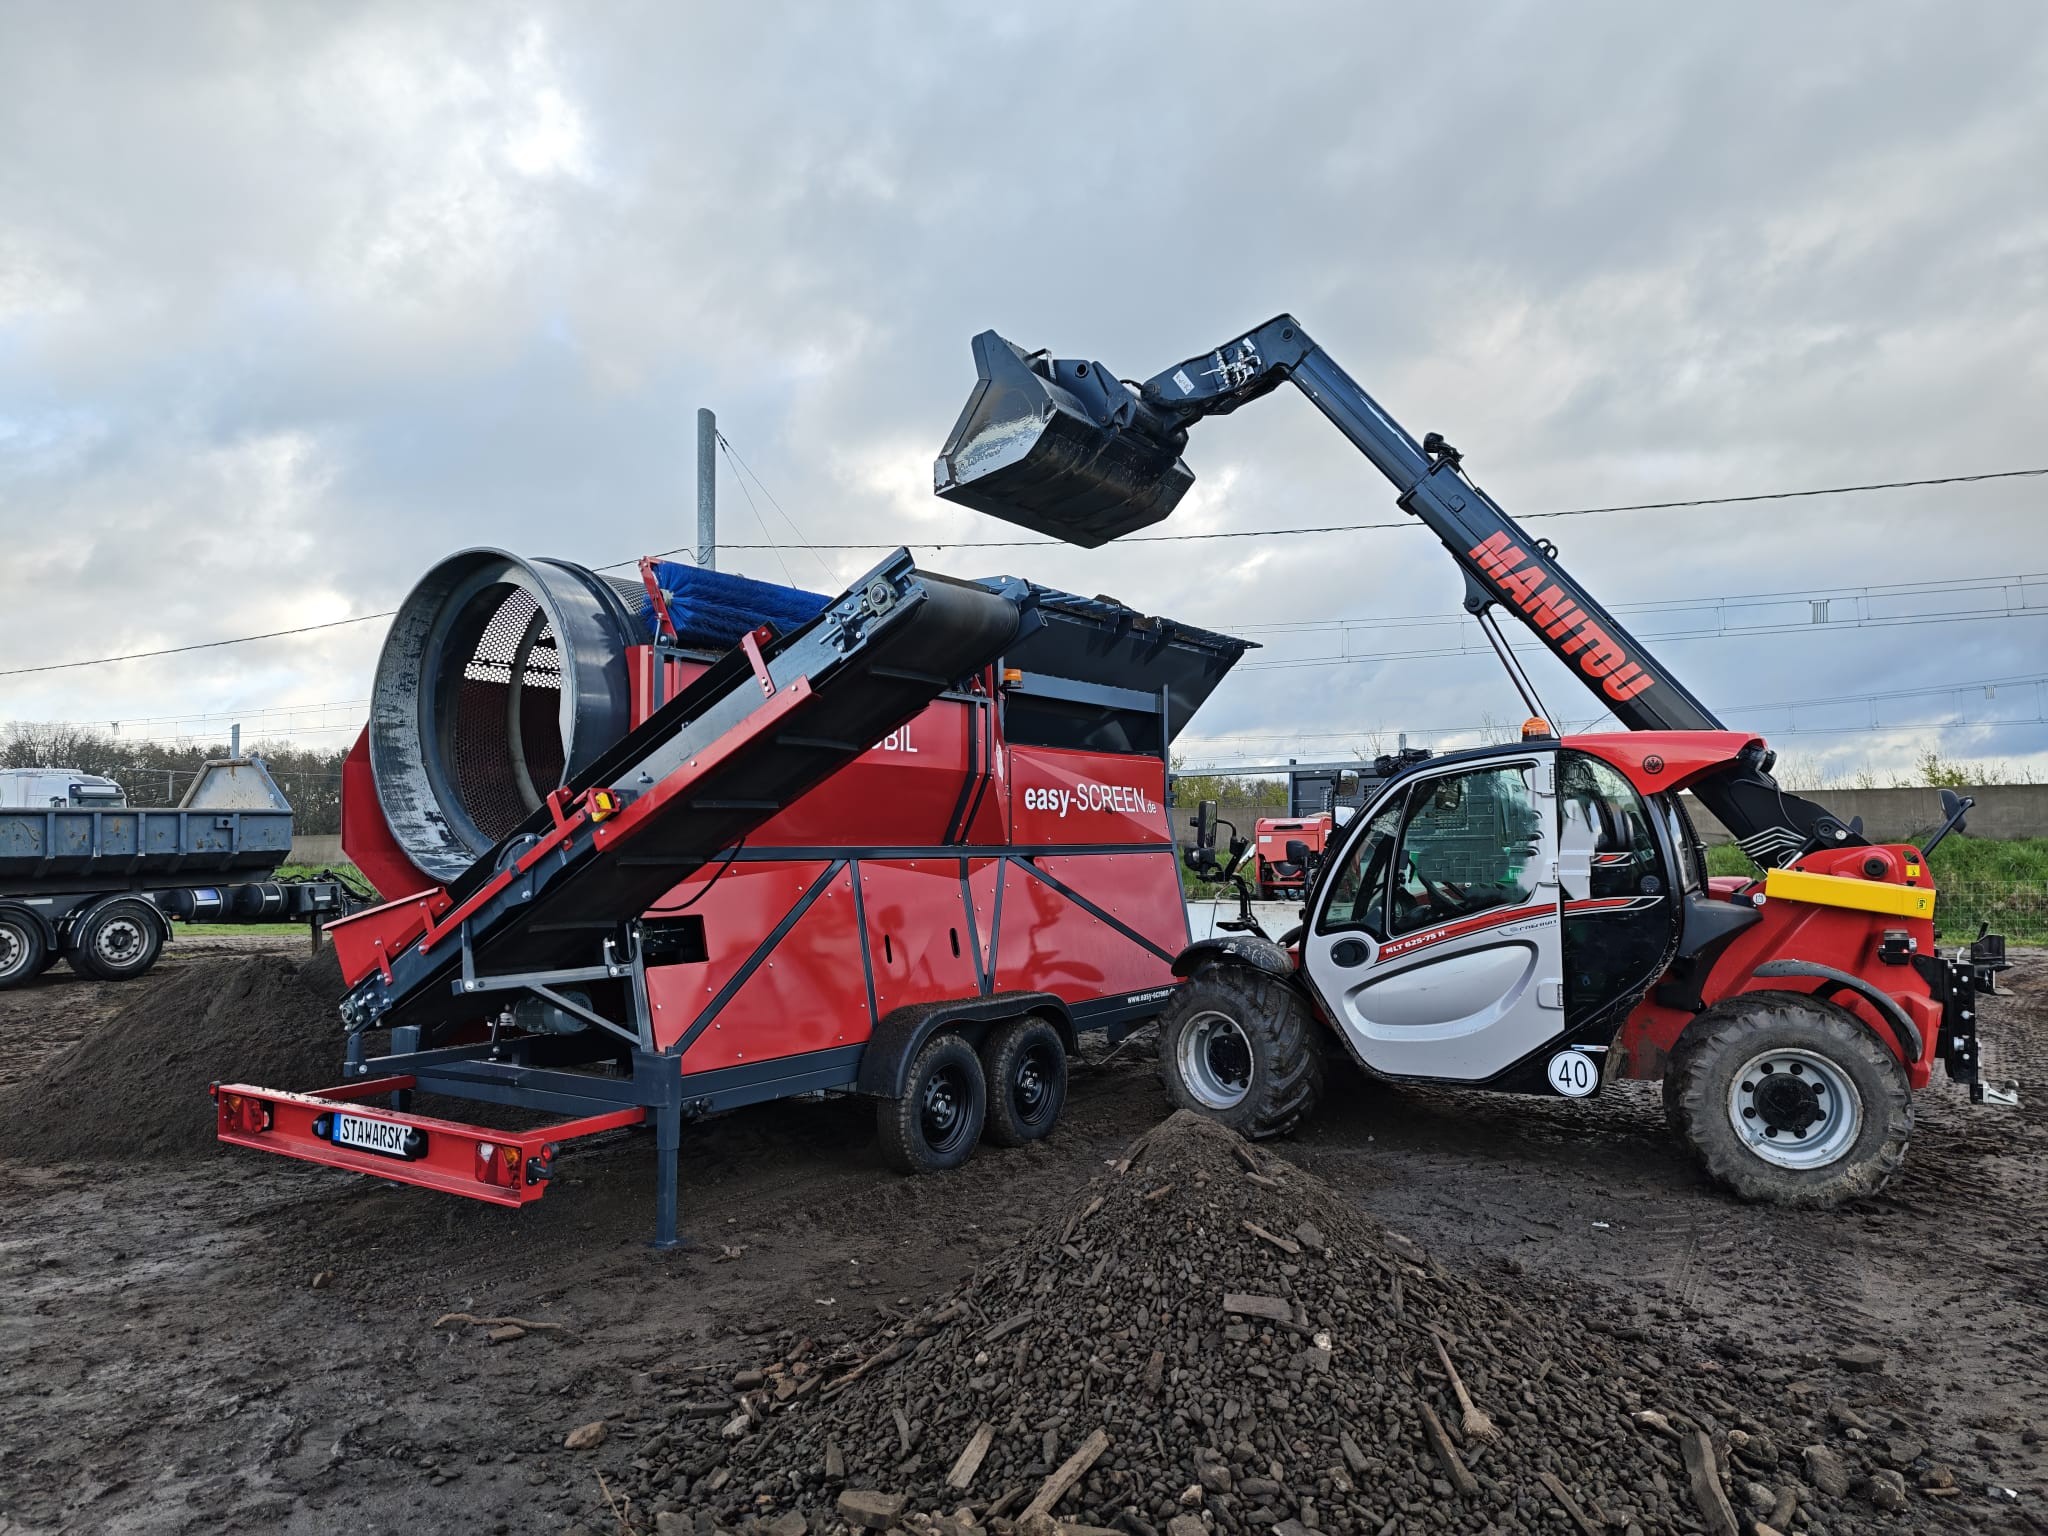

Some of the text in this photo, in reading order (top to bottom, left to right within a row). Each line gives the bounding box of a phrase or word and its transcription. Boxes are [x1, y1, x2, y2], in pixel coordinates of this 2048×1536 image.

[1468, 529, 1655, 701] MANITOU
[872, 725, 918, 753] BIL
[1386, 944, 1403, 953] MLT
[1405, 933, 1436, 947] 625-75
[1558, 1059, 1588, 1088] 40
[342, 1118, 411, 1151] STAWARSK
